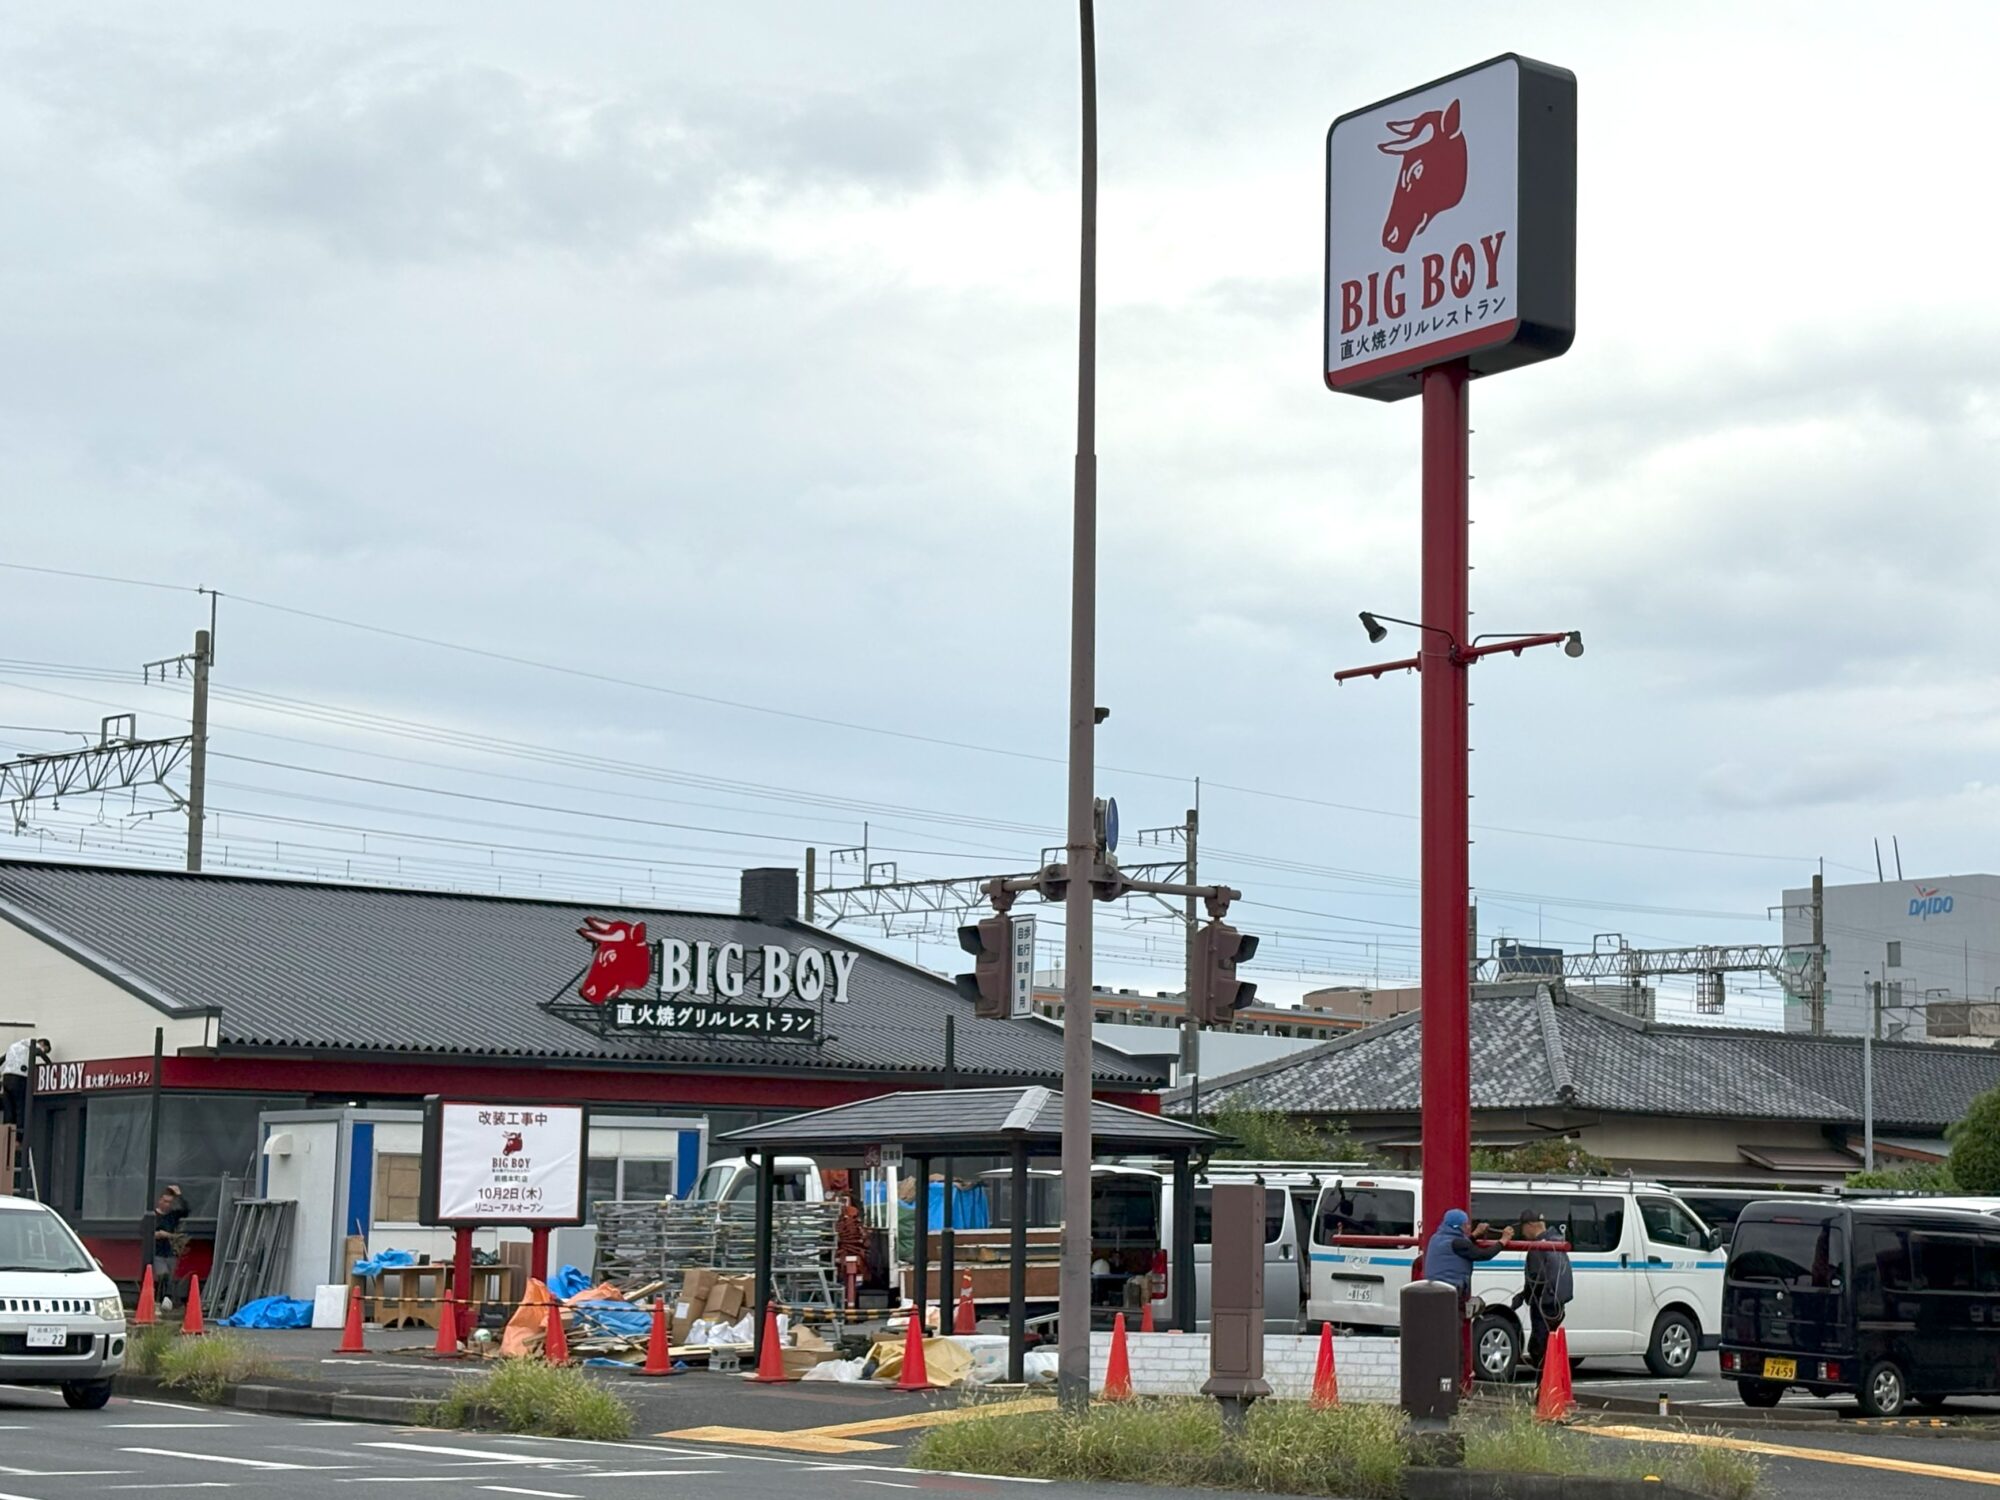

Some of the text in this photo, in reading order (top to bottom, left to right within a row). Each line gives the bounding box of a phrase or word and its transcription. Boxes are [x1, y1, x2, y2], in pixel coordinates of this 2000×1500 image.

[1340, 230, 1506, 335] BIG BOY
[1340, 296, 1506, 362] 直火焼グリルレストラン
[1908, 895, 1953, 921] DAIDO
[660, 938, 859, 1003] BIG BOY
[616, 1003, 811, 1032] 直火焼グリルレストラン
[37, 1062, 85, 1091] BIG BOY
[478, 1111, 548, 1126] 改装工事中
[492, 1158, 531, 1169] BIG BOY
[478, 1187, 543, 1200] 10月2日(木)
[475, 1203, 544, 1213] リニューアルオープン
